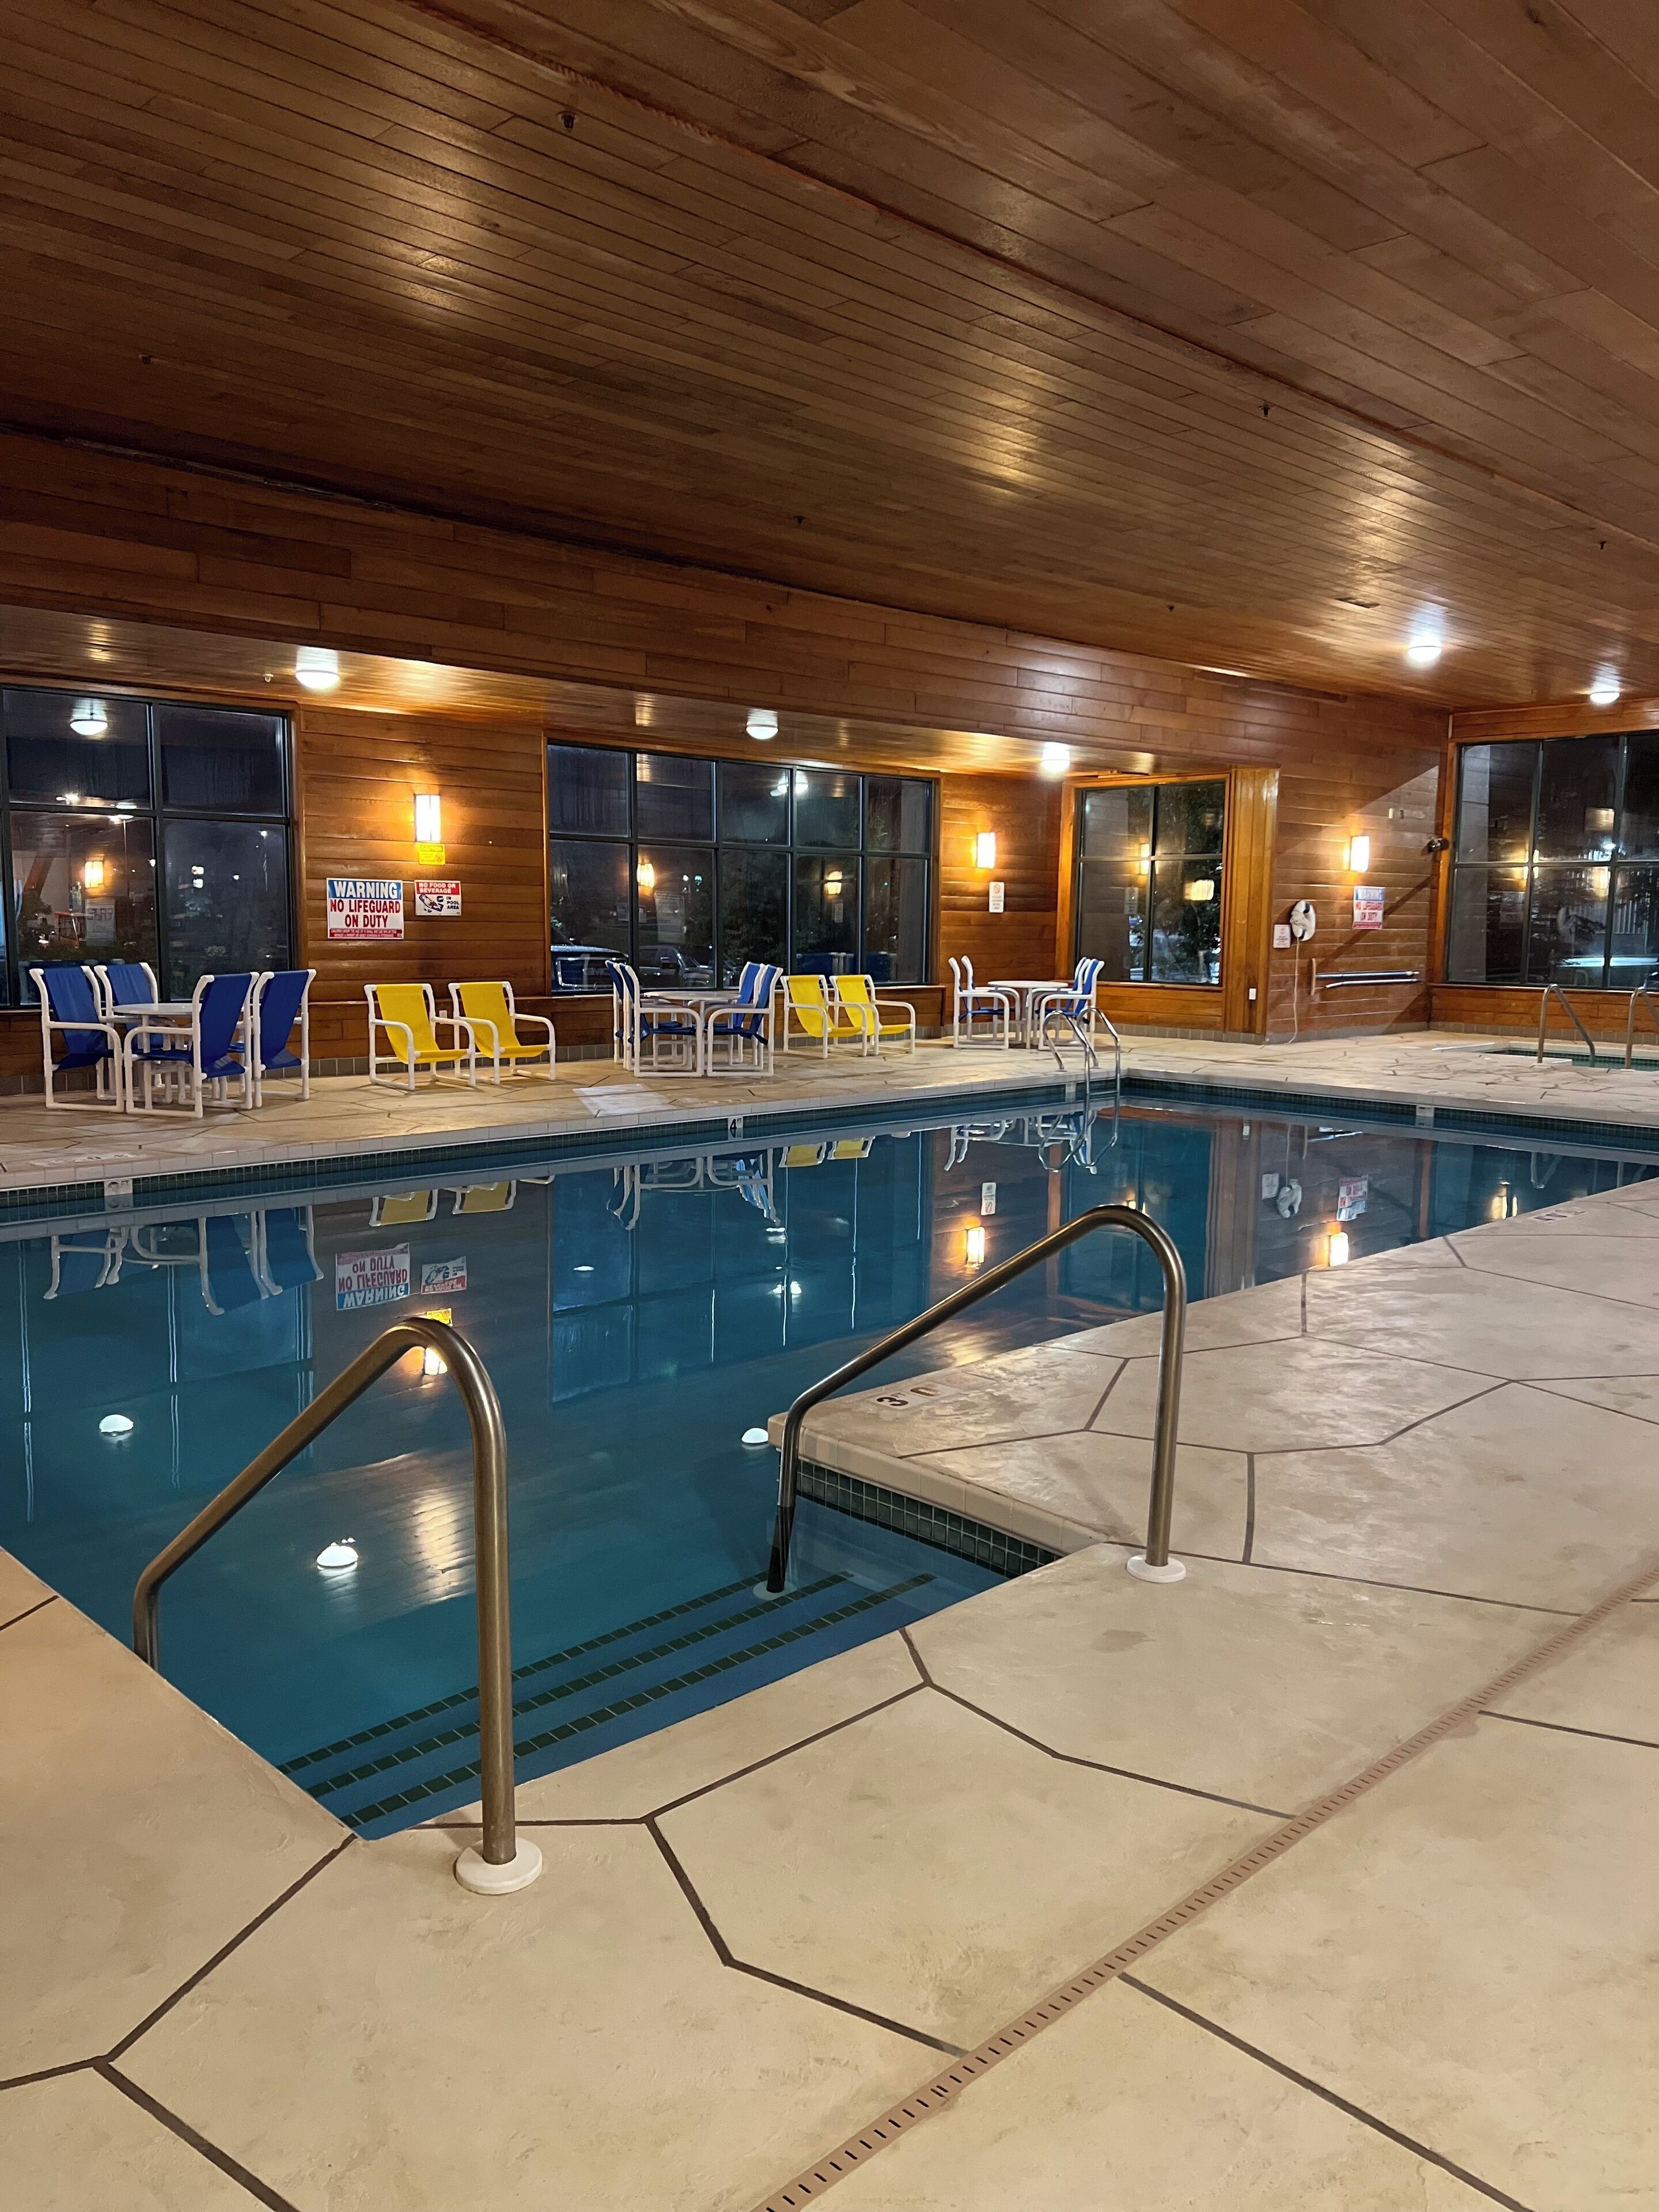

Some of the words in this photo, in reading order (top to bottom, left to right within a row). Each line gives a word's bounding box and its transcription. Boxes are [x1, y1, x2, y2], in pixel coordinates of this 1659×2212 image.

[334, 881, 397, 899] WARNING
[330, 899, 344, 912] NO
[349, 900, 400, 913] LIFEGUARD
[344, 914, 358, 927] ON
[363, 915, 388, 927] DUTY
[730, 1119, 737, 1129] 4
[876, 1397, 908, 1406] 3
